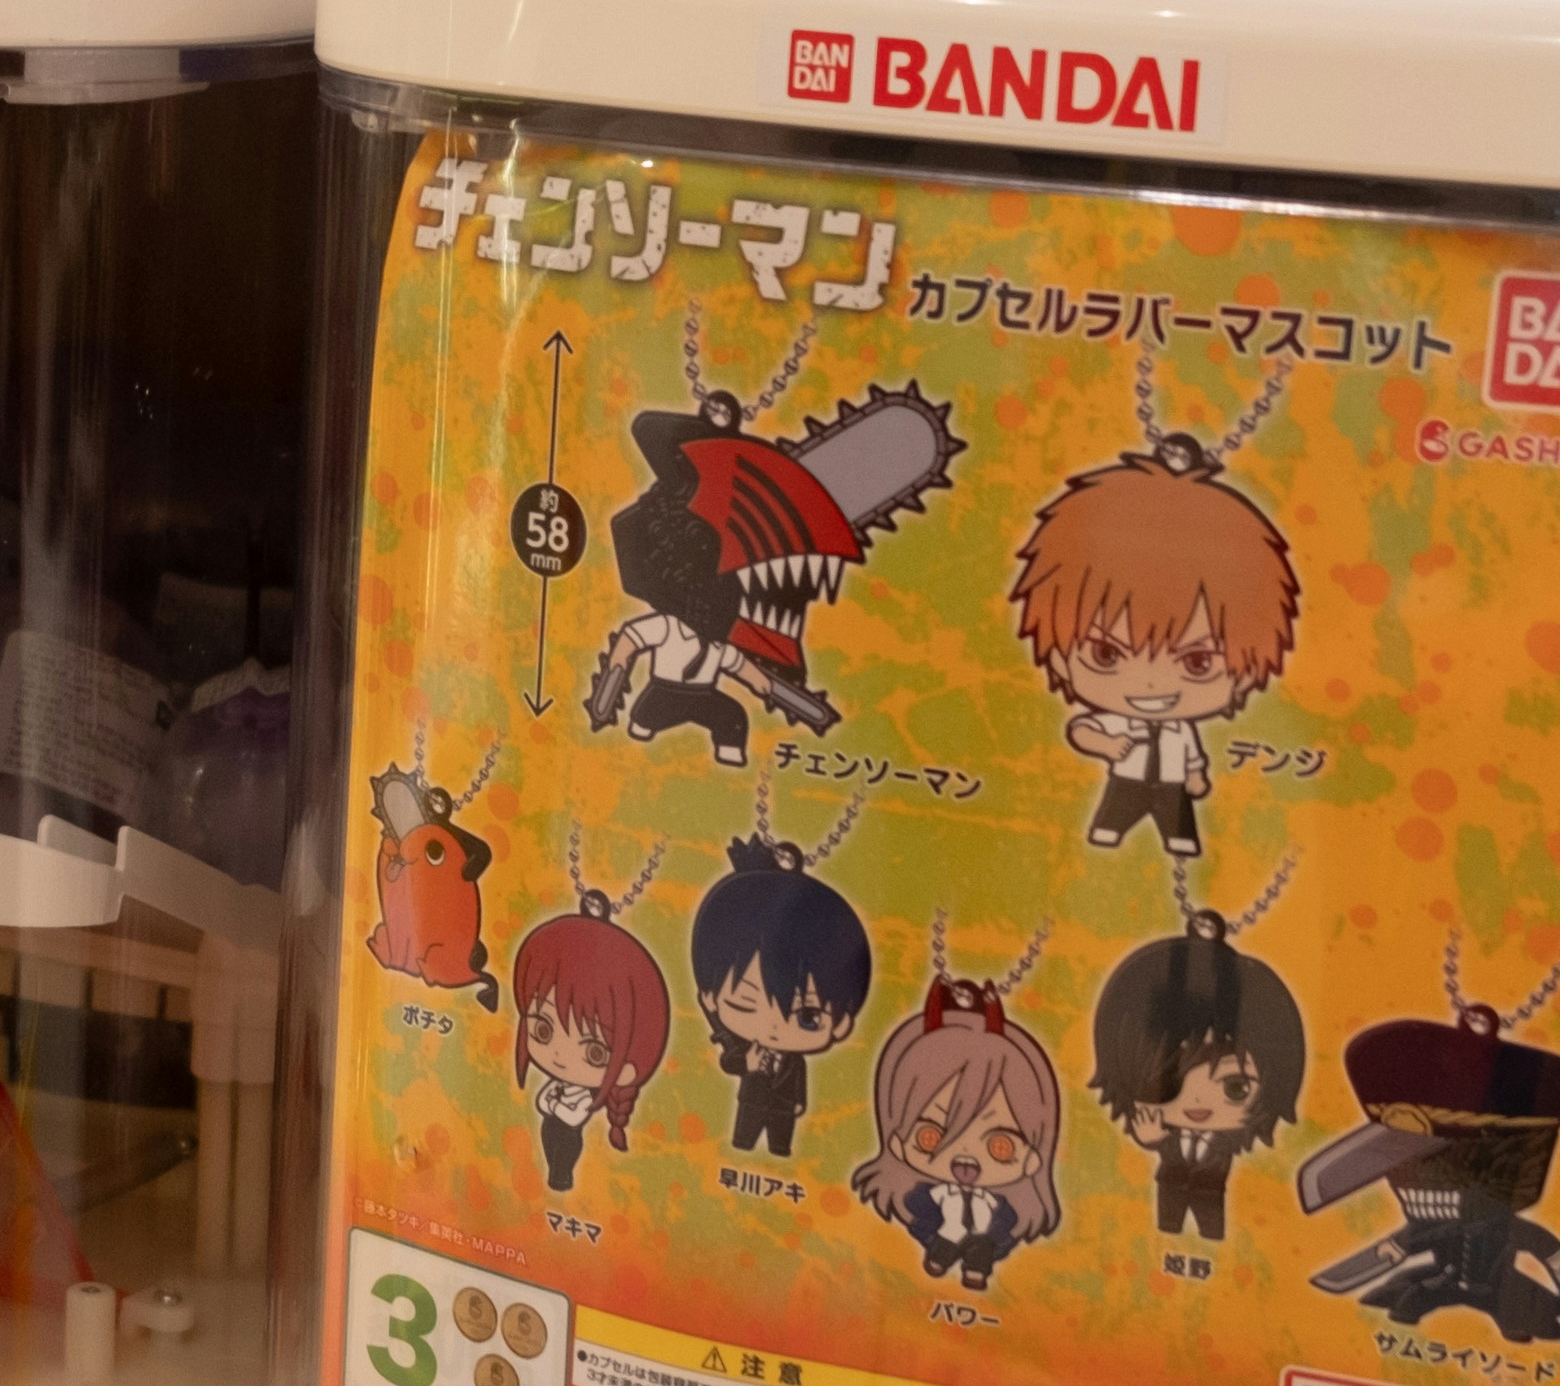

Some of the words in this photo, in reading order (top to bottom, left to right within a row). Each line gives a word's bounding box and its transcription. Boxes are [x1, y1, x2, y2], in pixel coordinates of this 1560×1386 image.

[871, 35, 1200, 135] BANDAI
[412, 154, 898, 317] チェンソーマン
[907, 271, 1456, 369] カプセルラバーマスコット
[524, 509, 571, 553] 58
[774, 739, 984, 805] チェンソーマン
[1225, 738, 1328, 780] デンジ
[718, 1164, 809, 1206] 早川アキ
[546, 1210, 602, 1243] マキマ
[1164, 1250, 1214, 1283] 姫野
[928, 1298, 1004, 1332] パワー
